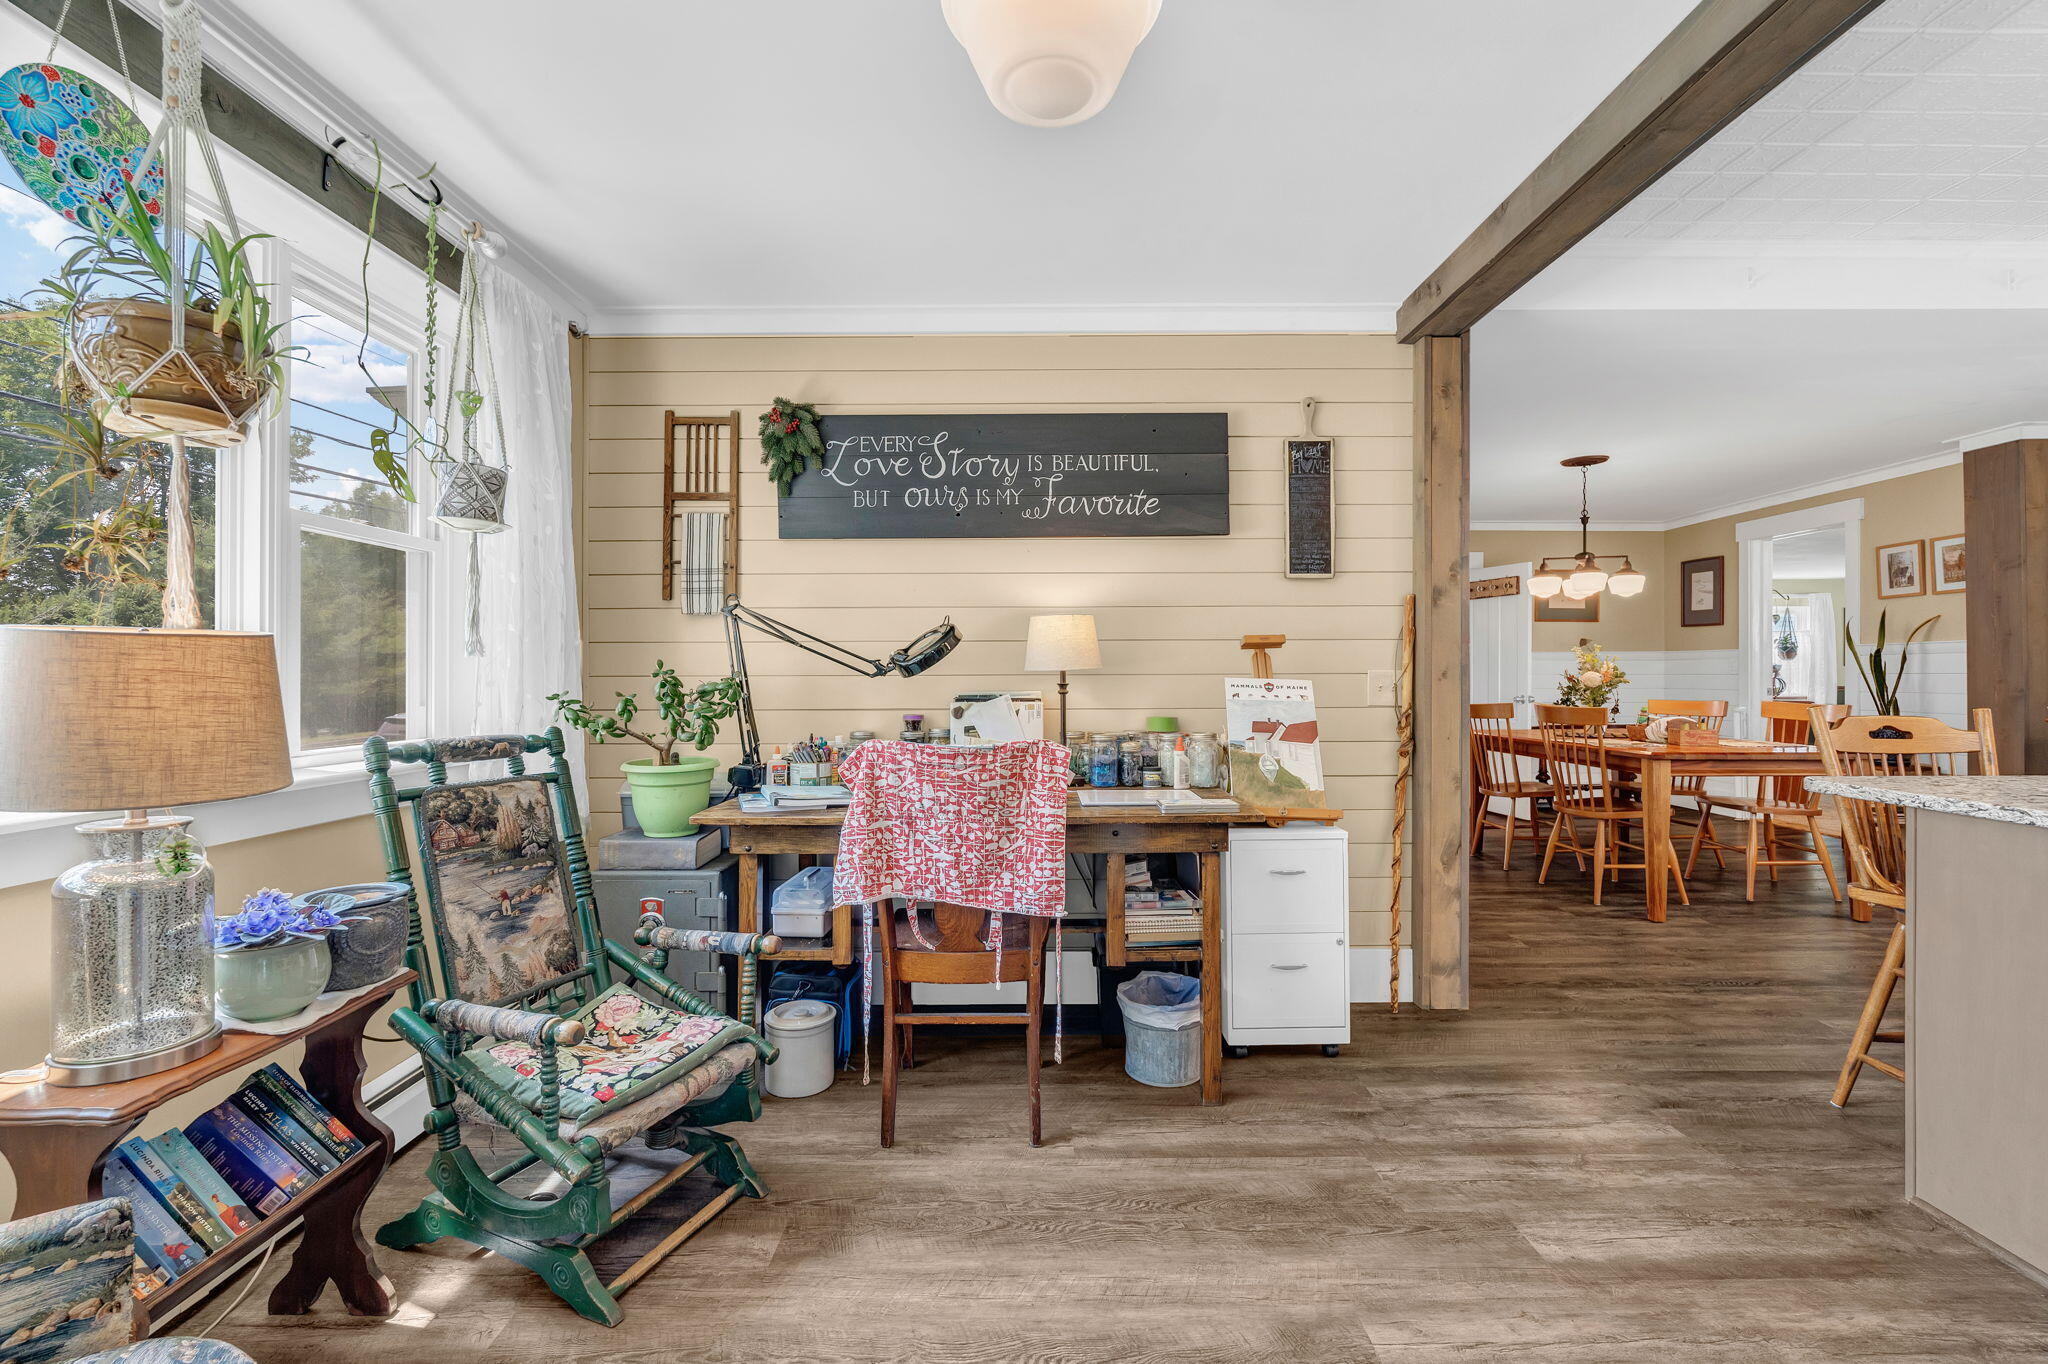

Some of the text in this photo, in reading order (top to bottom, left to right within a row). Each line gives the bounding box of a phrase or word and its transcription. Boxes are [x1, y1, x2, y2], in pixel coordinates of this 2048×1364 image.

[859, 435, 917, 453] EVERY
[820, 435, 913, 487] Love
[917, 431, 1020, 486] Story
[1027, 454, 1043, 473] IS
[852, 473, 1161, 520] BUT ours IS MY Favorite
[242, 1095, 259, 1111] RILEY
[244, 1088, 268, 1111] LUCINDA
[229, 1126, 257, 1151] Lucinda
[264, 1112, 295, 1138] ATLAS
[226, 1113, 288, 1169] THE MISSING SISTER
[289, 1139, 318, 1167] WHITTAKER
[300, 1140, 318, 1157] HARRY
[128, 1141, 172, 1188] LUCINDA RILEY
[115, 1176, 172, 1238] THE STORM SISTER
[175, 1192, 198, 1216] SHADOW
[195, 1214, 213, 1233] SISTER
